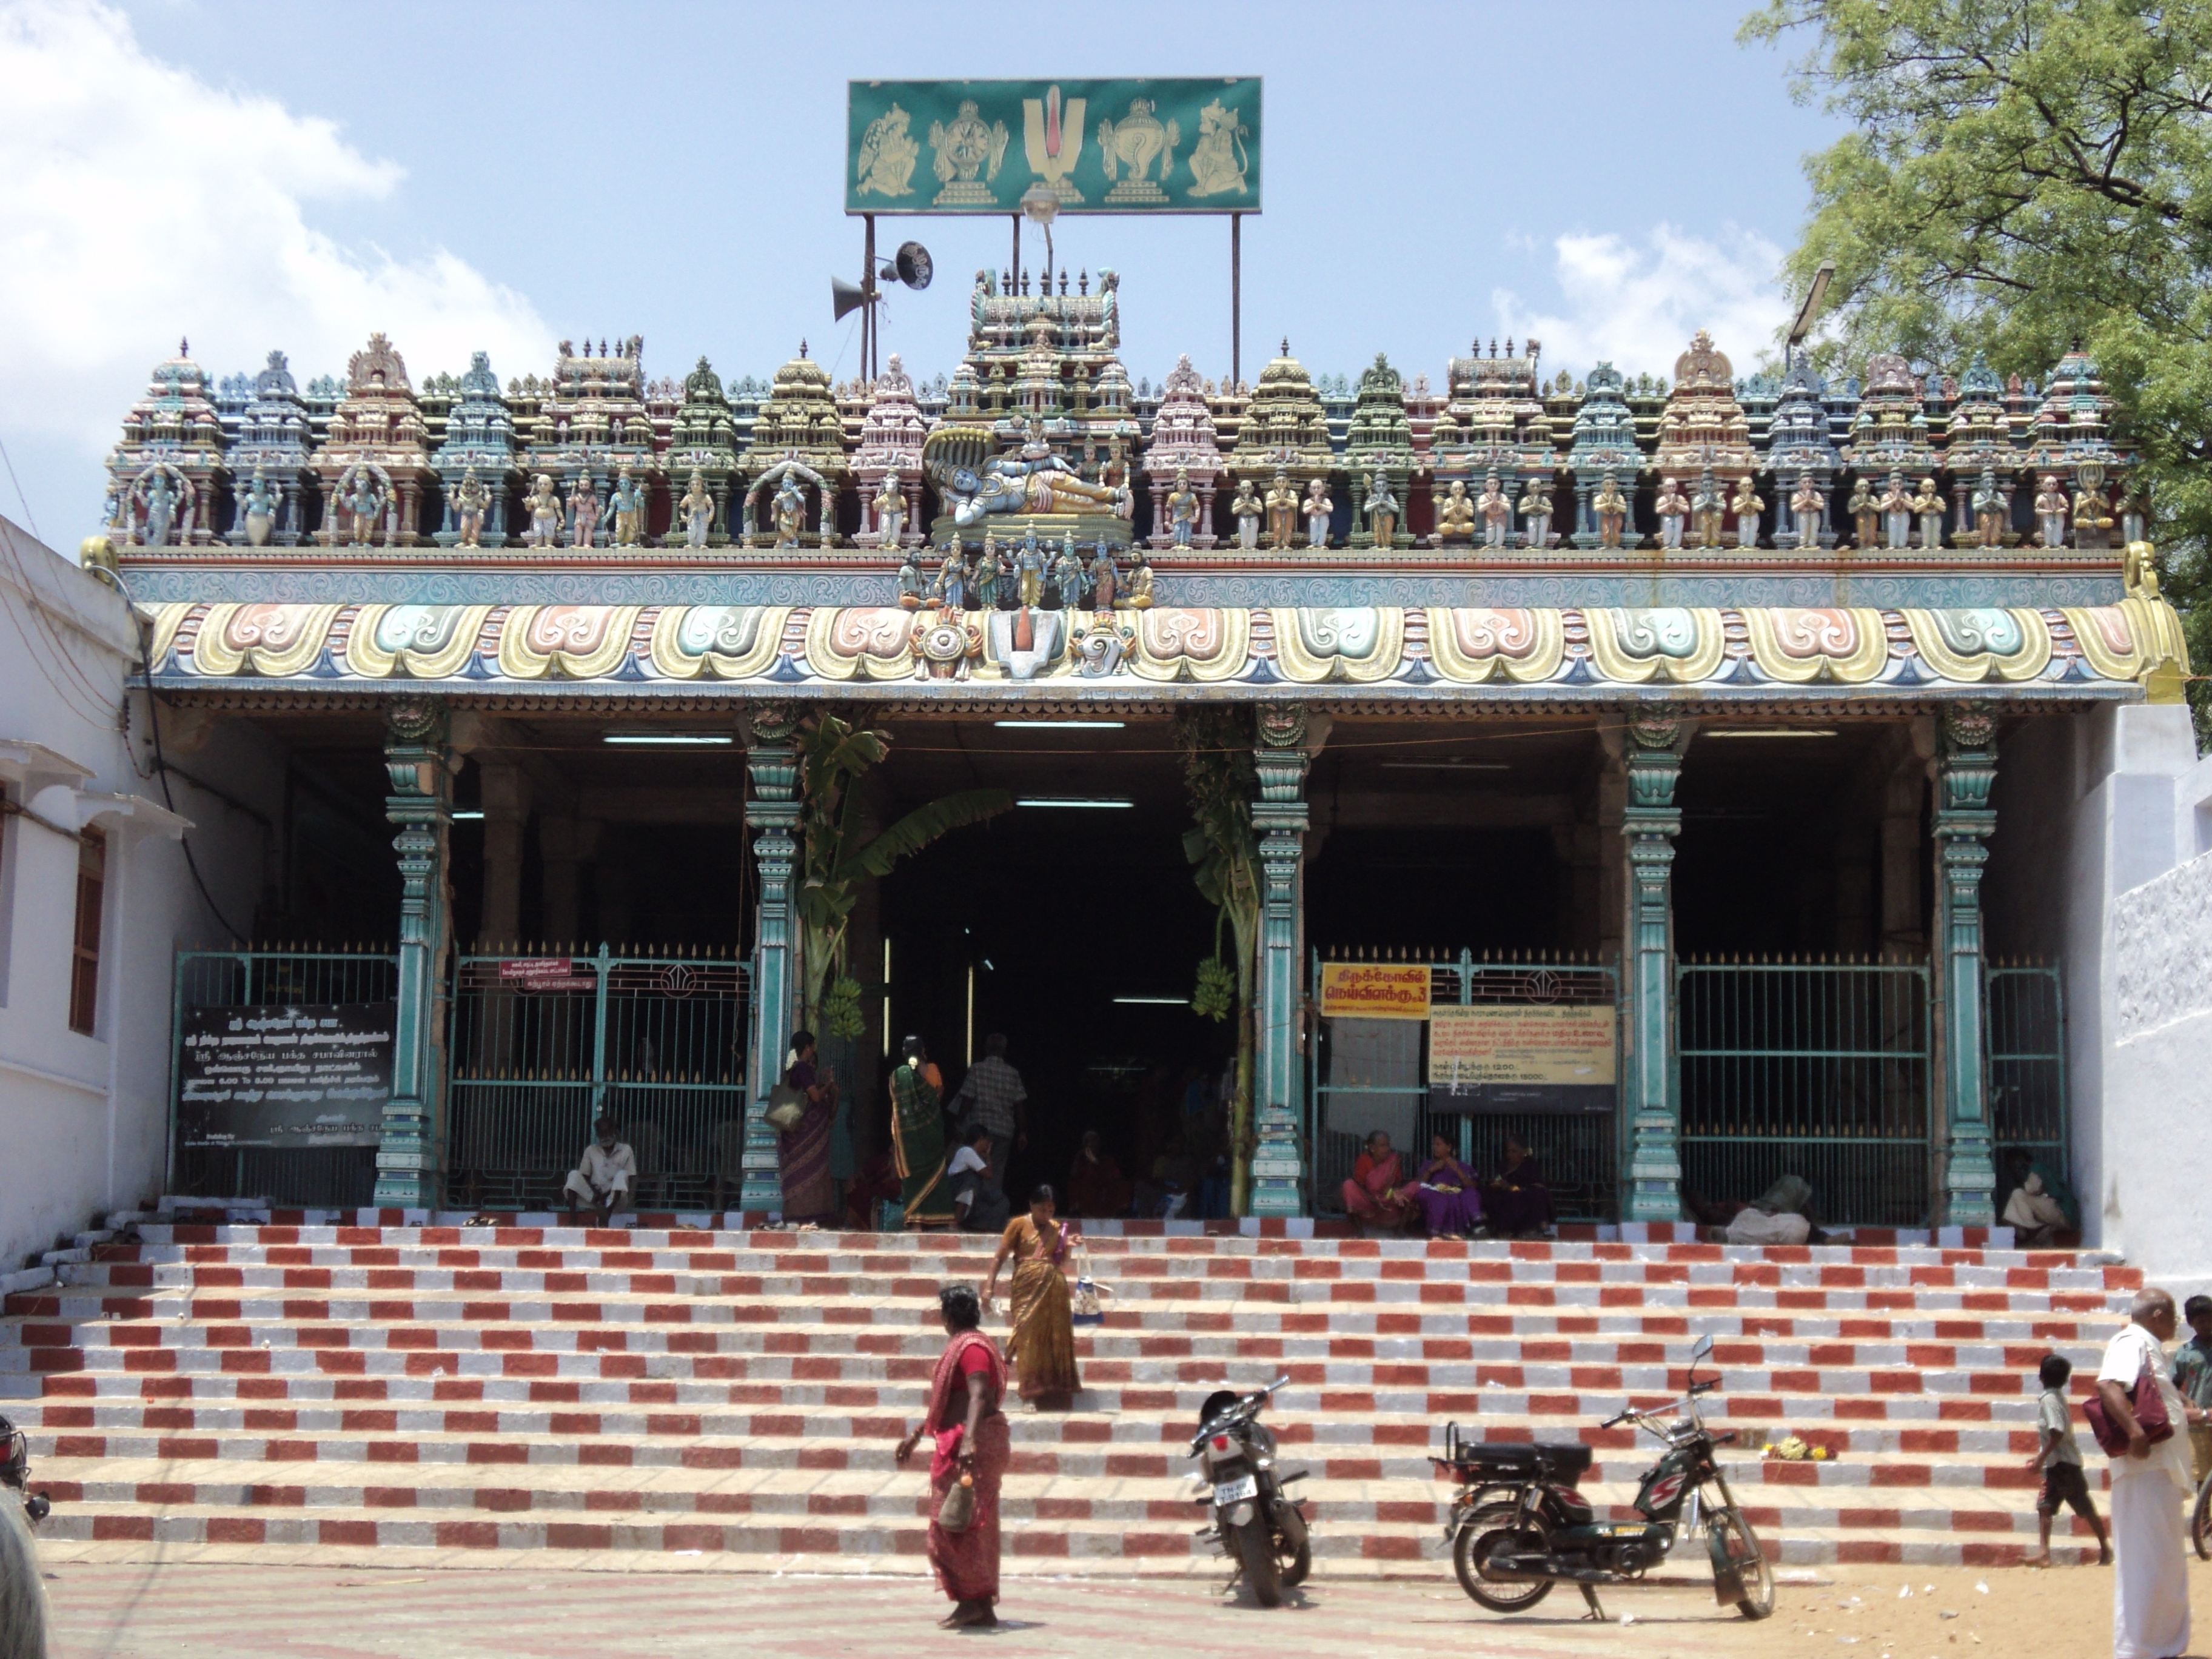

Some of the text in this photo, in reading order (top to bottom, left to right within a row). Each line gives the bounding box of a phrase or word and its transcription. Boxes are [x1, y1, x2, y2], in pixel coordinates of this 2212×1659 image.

[1338, 968, 1426, 984] திருக்கோவில்
[528, 979, 592, 988] கற்பூரம் ஏற்றக்கூடாது
[195, 1048, 378, 1062] ஸ்ரீ ஆஞ்சநேய பக்த சபாவினரால்
